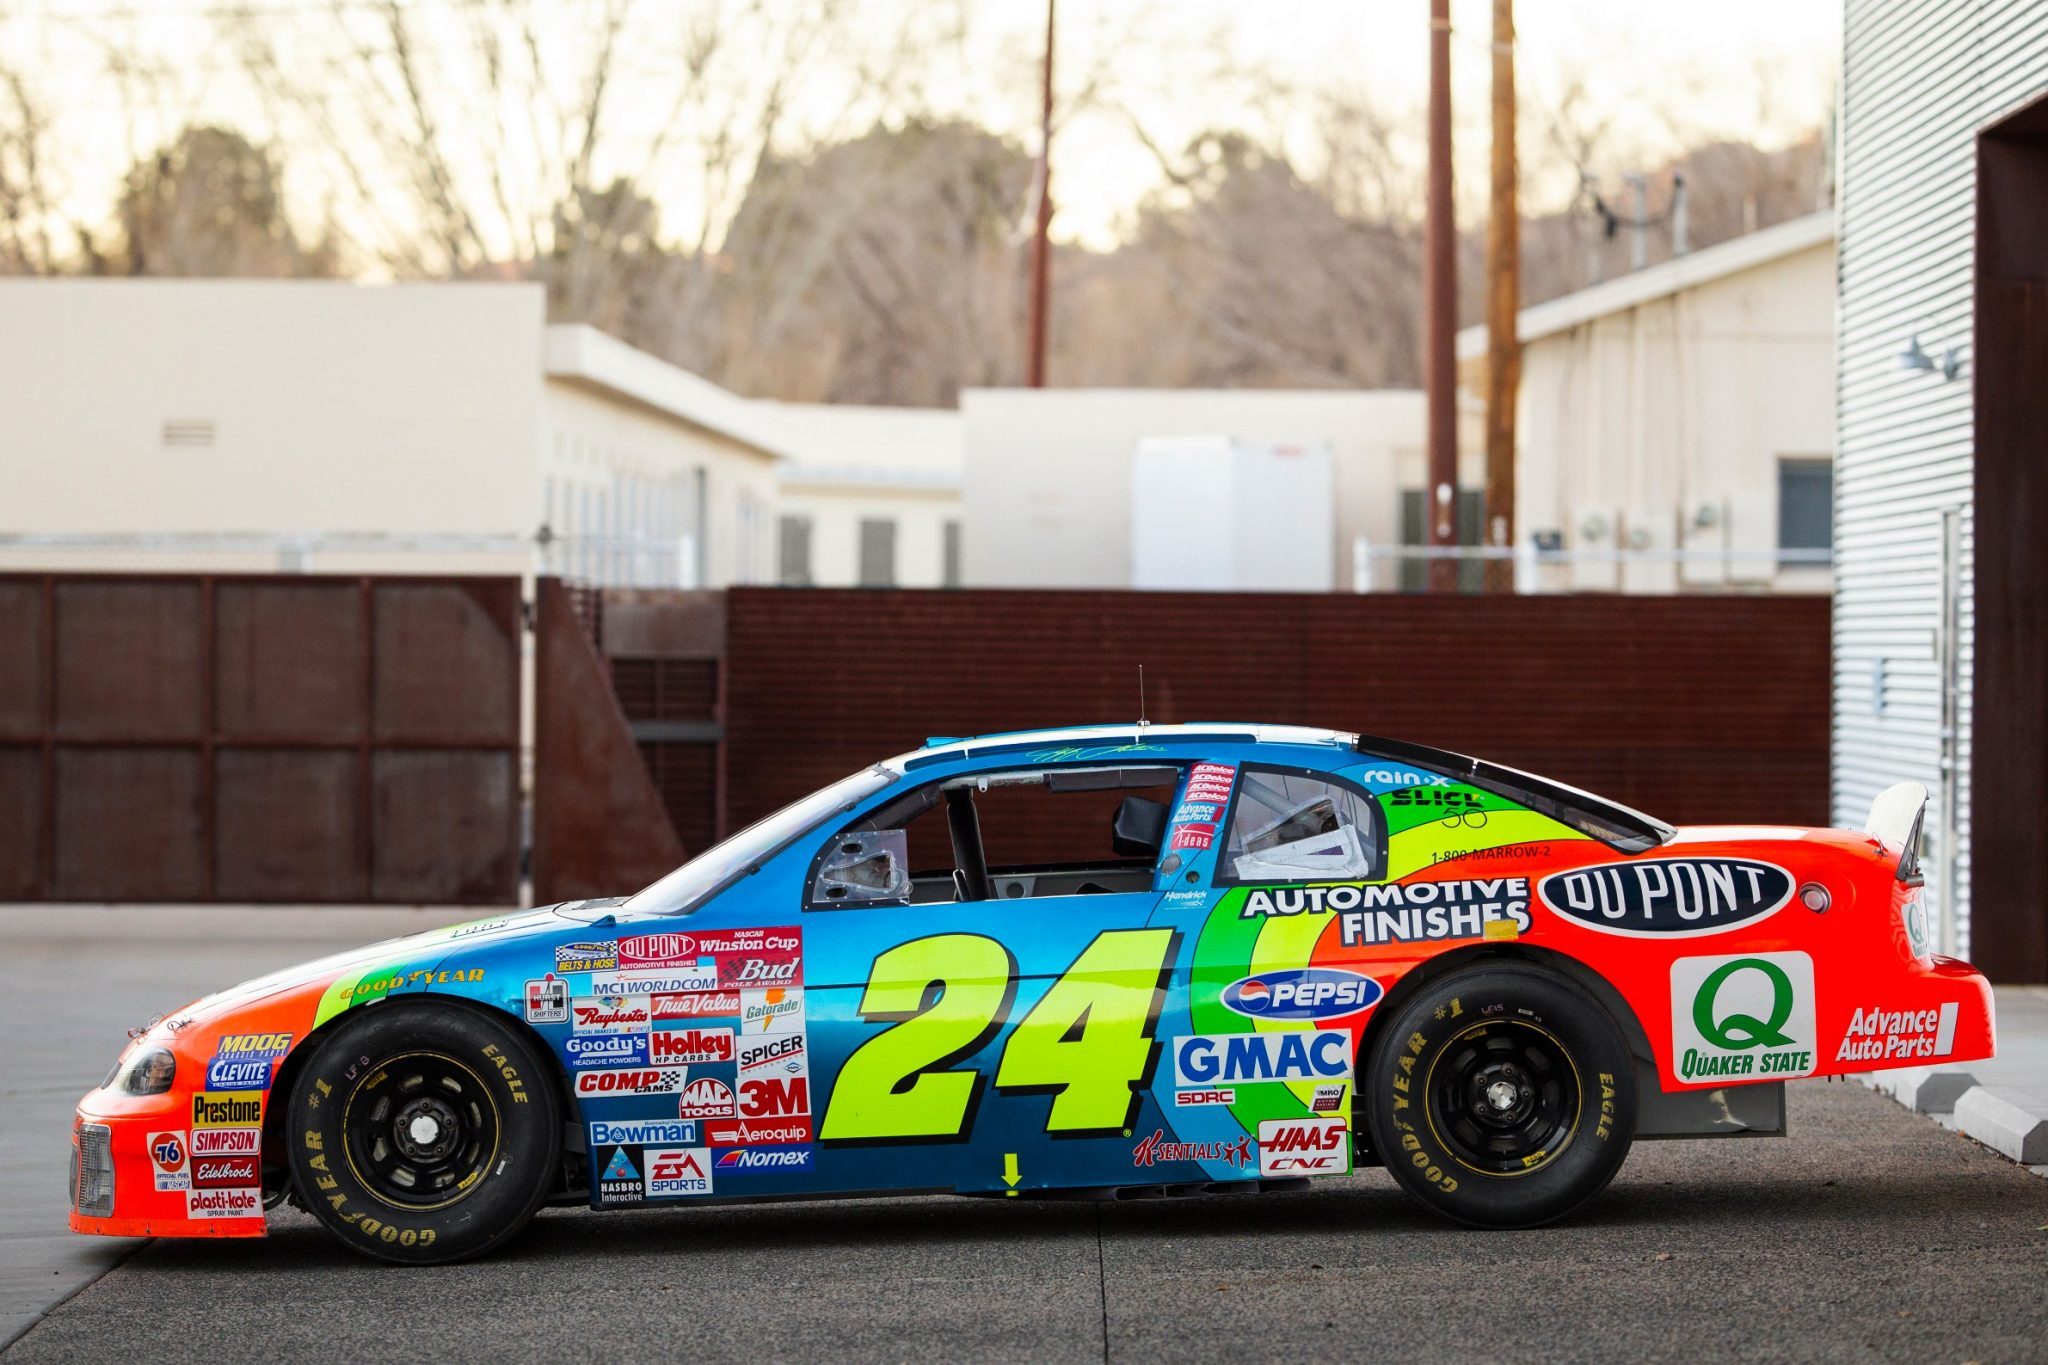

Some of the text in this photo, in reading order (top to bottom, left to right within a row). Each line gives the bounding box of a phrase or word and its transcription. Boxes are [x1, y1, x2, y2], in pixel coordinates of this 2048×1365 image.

[1190, 774, 1233, 783] ACDelco
[1193, 765, 1235, 774] ACDelco
[1186, 792, 1228, 801] ACDelco
[1188, 783, 1230, 792] ACDelco
[1179, 804, 1215, 813] Advance
[1190, 812, 1212, 821] Parts
[1441, 808, 1488, 828] 50
[1431, 845, 1551, 865] 1-800-MARROW-2
[1164, 891, 1208, 901] Hendrick
[1243, 877, 1528, 917] AUTOMOTIVE
[1562, 862, 1766, 921] DU PONT
[1343, 901, 1530, 945] FINISHES
[734, 930, 764, 938] NASCAR
[626, 936, 689, 958] DU PONT
[700, 936, 799, 953] Winston Cup
[558, 957, 616, 971] BELTS & HOSE
[620, 959, 696, 970] AUTOMOTIVE FINISHES
[738, 957, 801, 981] Bud
[593, 978, 716, 995] MCI WORLDCOM
[724, 978, 792, 988] POLE AWARD
[533, 993, 561, 1002] HURST
[692, 994, 741, 1013] Value
[1272, 981, 1368, 1008] PEPSI
[1692, 957, 1797, 1051] Q
[533, 1010, 562, 1018] SHIFTERS
[574, 1008, 649, 1028] Raybestos
[746, 998, 799, 1018] Gatorade
[1845, 1006, 1938, 1037] Advance
[218, 1033, 293, 1053] MOOG
[817, 926, 1177, 1142] 24
[220, 1049, 286, 1059] CHASSIS PARTS
[566, 1036, 646, 1057] Goody's
[652, 1029, 731, 1060] Holley
[740, 1035, 803, 1065] SPICER
[1836, 1033, 1935, 1061] Auto Parts
[609, 1056, 641, 1064] POWDERS
[655, 1053, 712, 1063] HP CARBS
[1178, 1032, 1349, 1083] GMAC
[1681, 1047, 1811, 1079] QUAKER STATE
[211, 1060, 268, 1082] CLEVITE
[481, 1044, 528, 1104] EAGLE
[579, 1071, 660, 1092] COMP
[634, 1084, 673, 1094] CAMS
[682, 1081, 735, 1107] MAC
[739, 1077, 808, 1117] 3M
[1177, 1091, 1234, 1105] SDRC
[194, 1098, 260, 1123] Prestone
[681, 1107, 733, 1117] TOOLS
[1595, 1072, 1617, 1142] EAGLE
[195, 1131, 255, 1150] SIMPSON
[736, 1121, 806, 1143] Aeroquip
[1264, 1124, 1345, 1152] HAAS
[156, 1141, 180, 1163] 76
[1133, 1128, 1222, 1167] K-SENTIALS
[652, 1153, 705, 1179] EA
[738, 1150, 807, 1167] Nomex
[1268, 1156, 1338, 1171] CNC
[198, 1163, 253, 1180] Edelbrock
[601, 1182, 642, 1192] HASBRO
[652, 1179, 706, 1192] SPORTS
[191, 1191, 257, 1211] plasti-kote
[601, 1191, 643, 1202] Interactive
